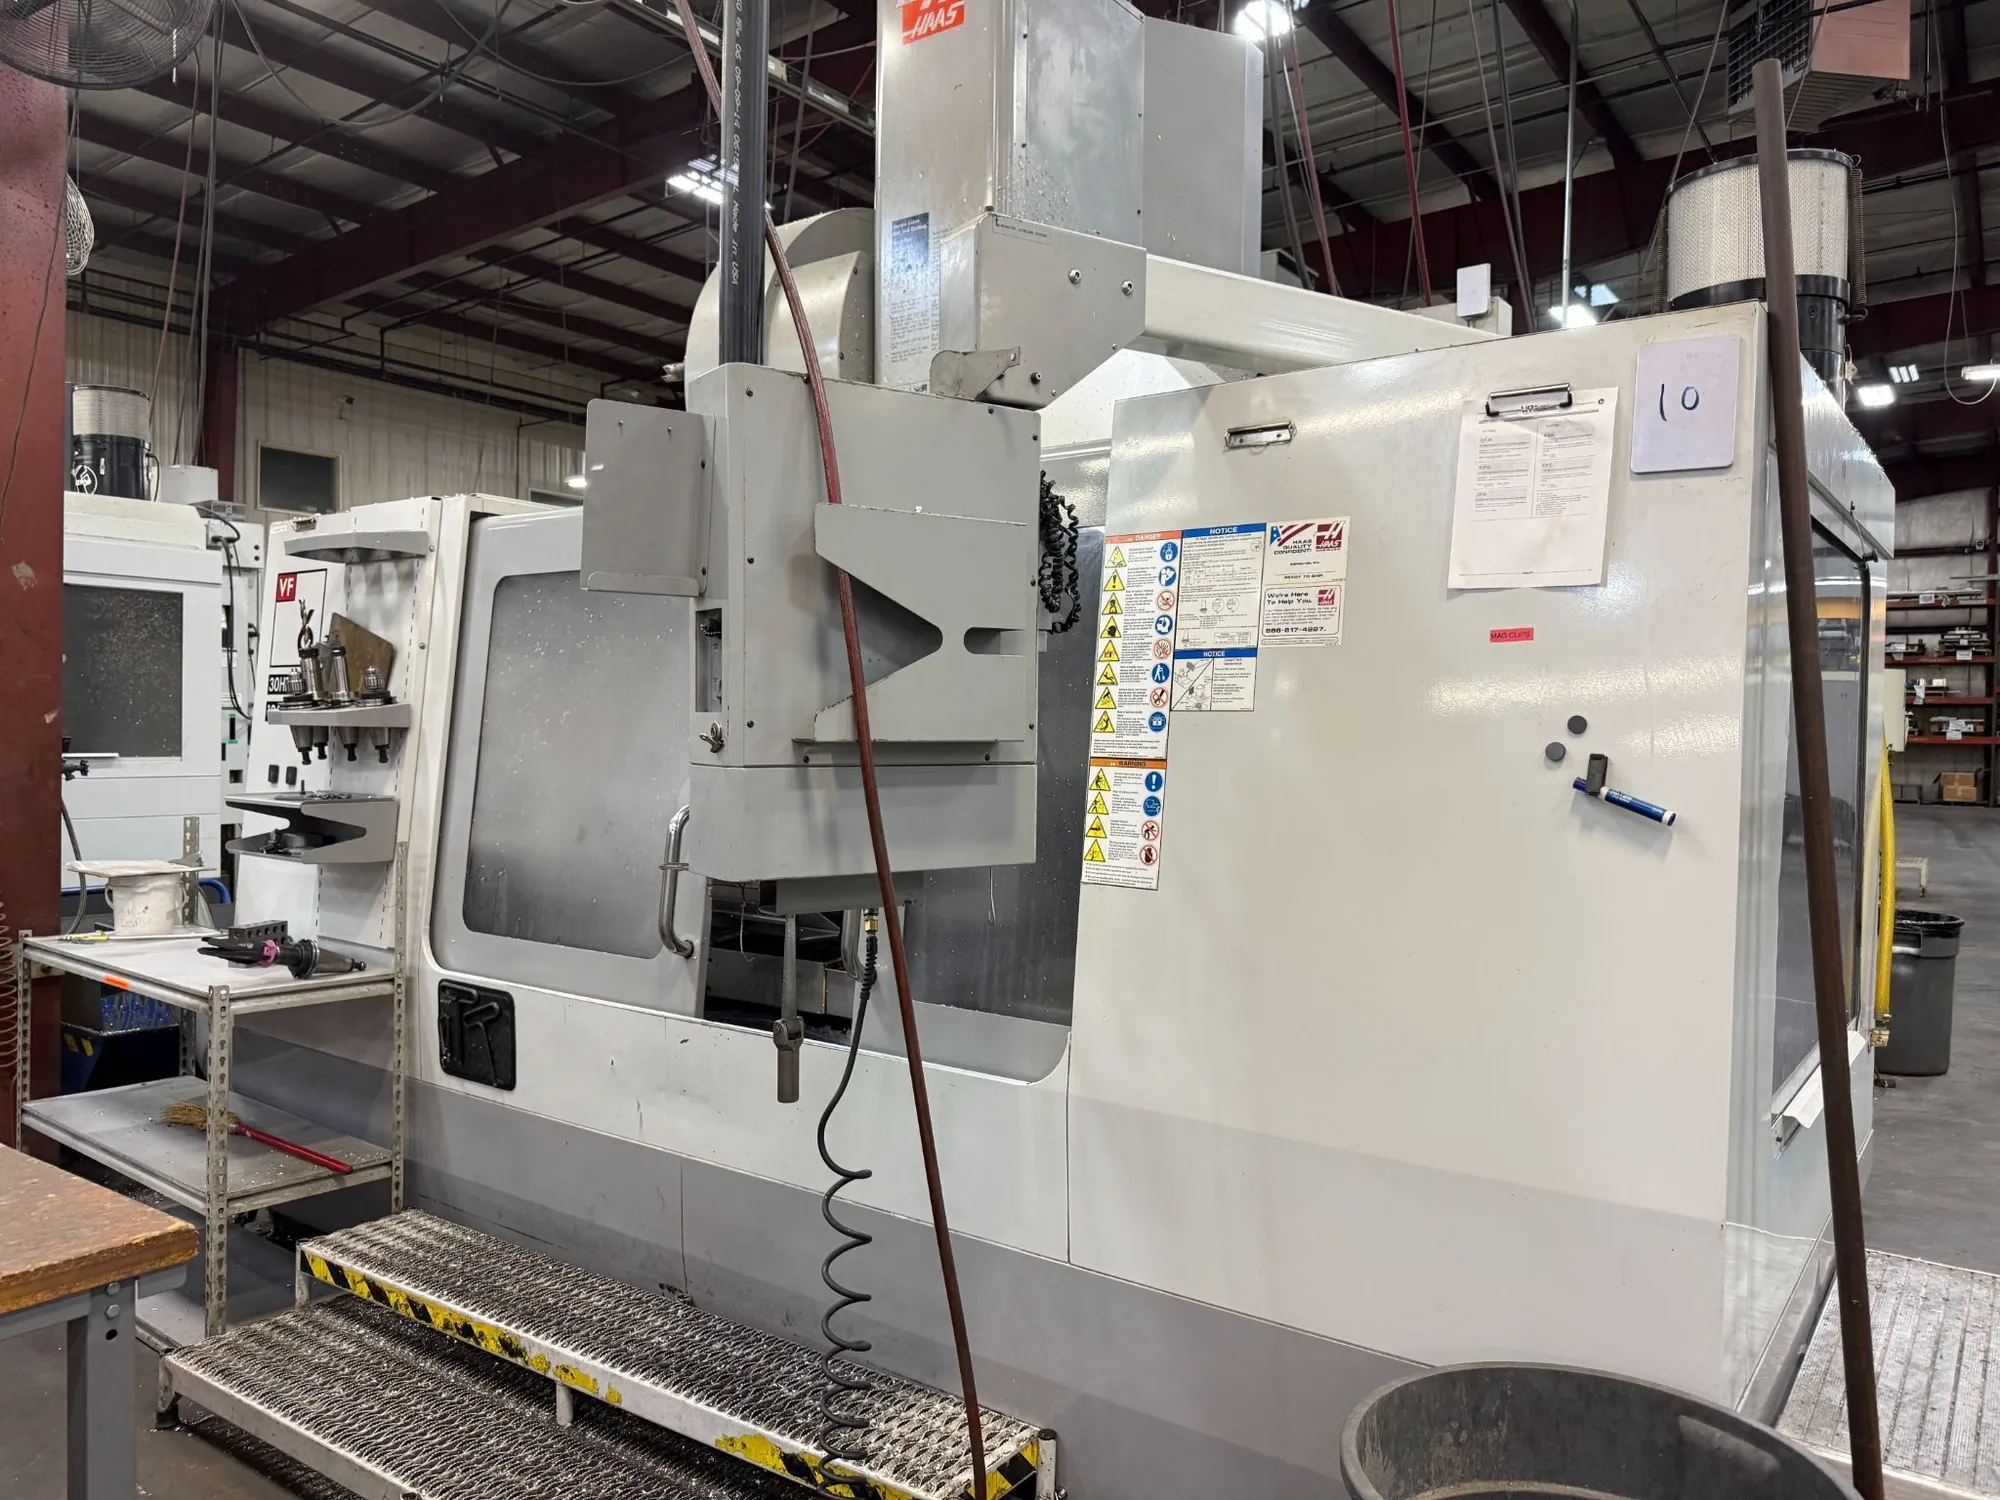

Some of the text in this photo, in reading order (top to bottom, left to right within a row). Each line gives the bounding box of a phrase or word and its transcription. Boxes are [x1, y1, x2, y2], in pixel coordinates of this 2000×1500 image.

[902, 1, 965, 39] HAAS
[731, 261, 740, 285] USA
[1659, 383, 1700, 421] 10
[1135, 533, 1162, 541] DANGER
[1209, 526, 1238, 535] NOTICE
[1319, 540, 1341, 548] HAAS
[279, 577, 294, 597] VF
